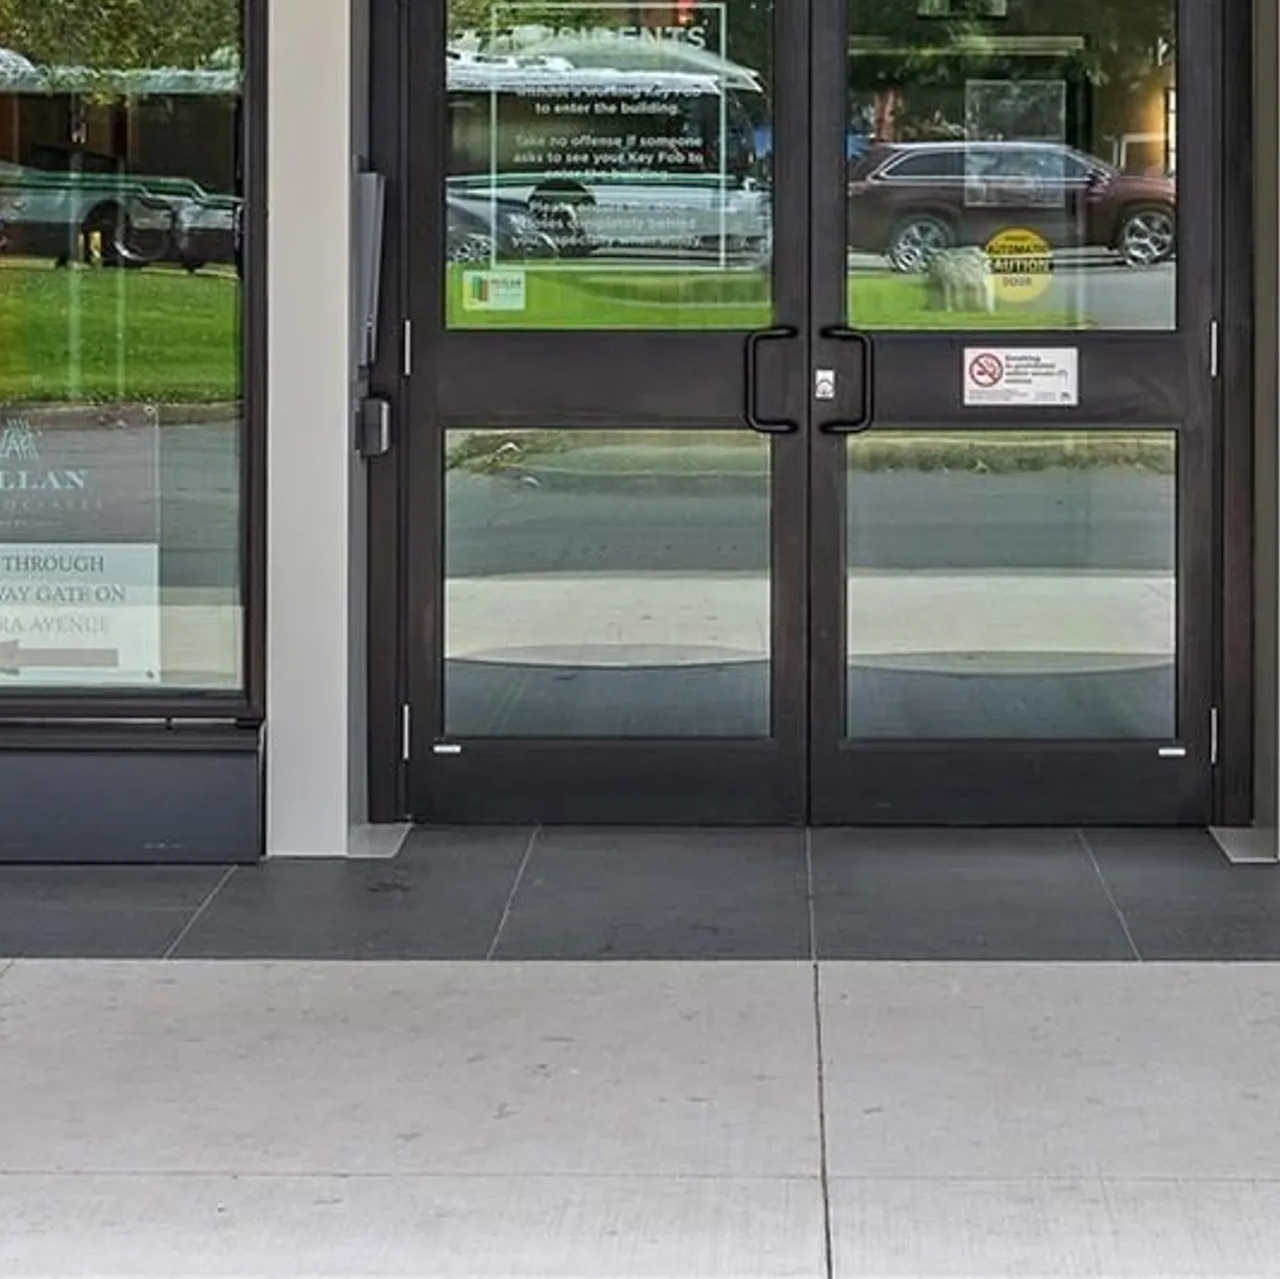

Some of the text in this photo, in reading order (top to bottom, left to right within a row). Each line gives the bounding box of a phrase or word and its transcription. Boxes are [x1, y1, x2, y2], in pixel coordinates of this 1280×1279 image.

[535, 102, 551, 115] to
[554, 103, 591, 115] enter
[594, 102, 617, 115] the
[549, 138, 567, 147] no
[570, 134, 622, 148] offense
[625, 135, 638, 147] if
[639, 136, 704, 148] someone
[513, 152, 544, 164] asks
[546, 152, 562, 164] to
[565, 154, 589, 164] see
[627, 152, 655, 167] Key
[658, 152, 686, 164] Fob
[2, 555, 105, 573] THROUGH
[35, 585, 89, 603] GATE
[94, 584, 126, 603] ON
